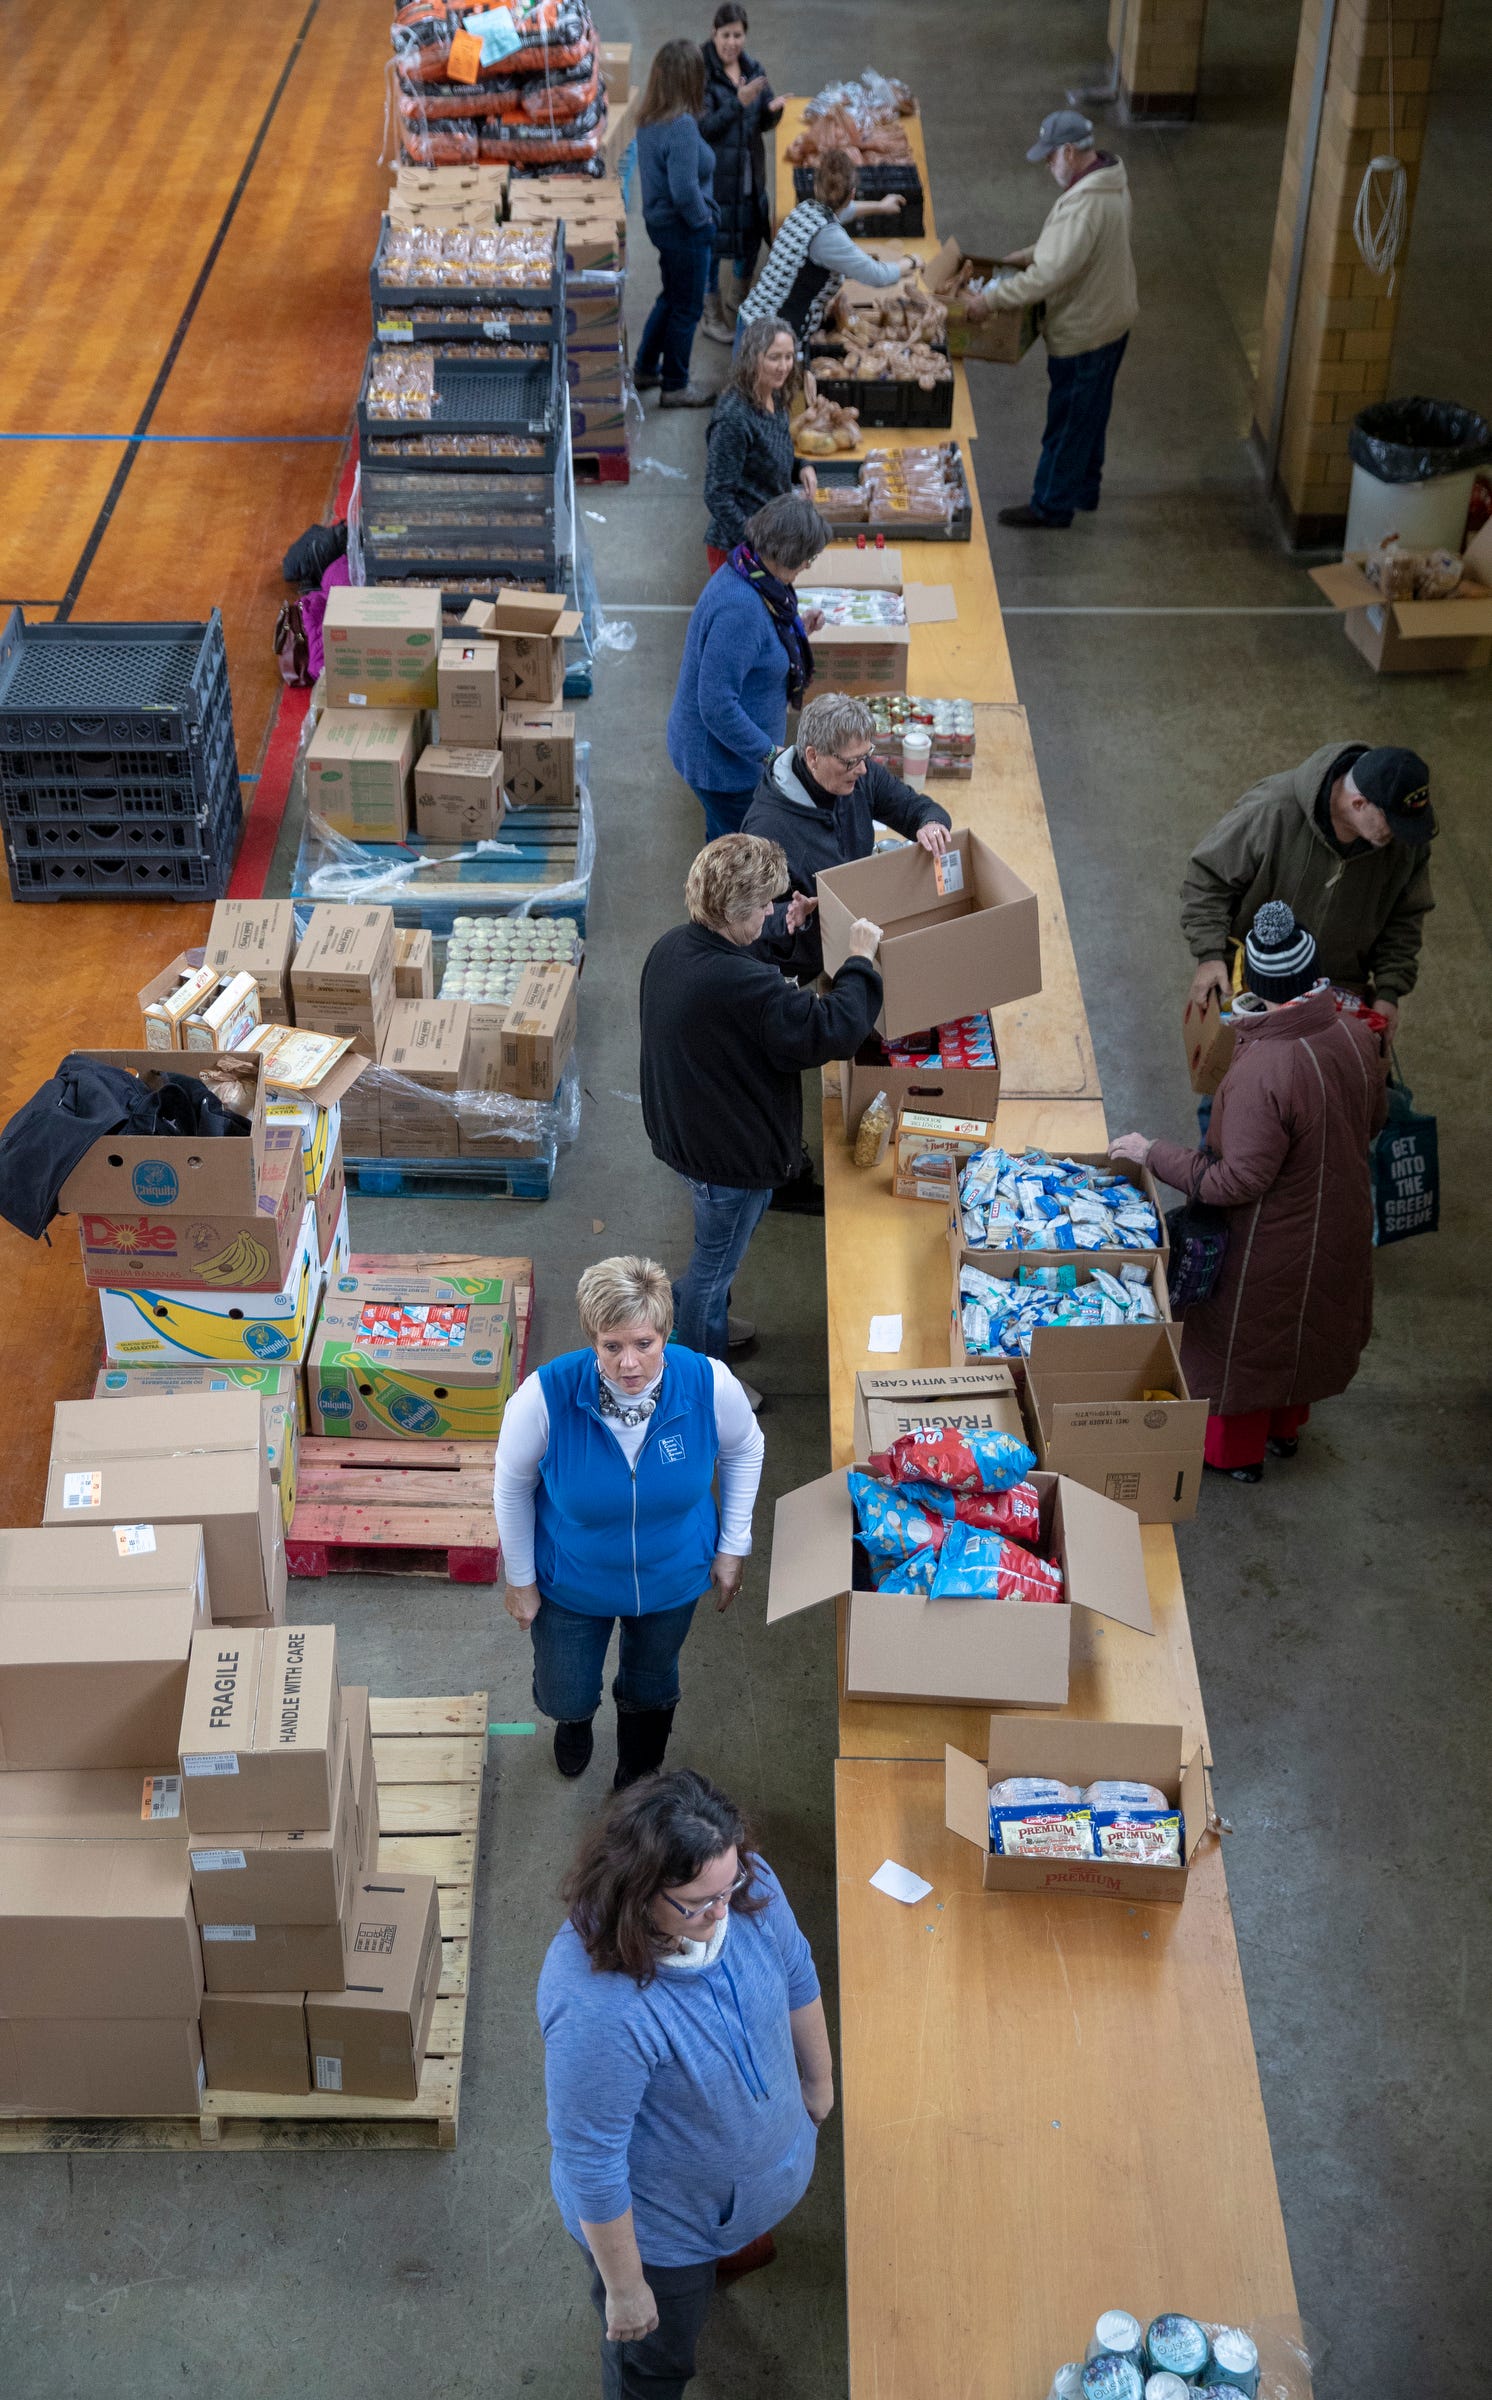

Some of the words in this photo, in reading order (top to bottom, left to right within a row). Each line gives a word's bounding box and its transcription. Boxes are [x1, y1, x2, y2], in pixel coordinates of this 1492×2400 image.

[1391, 1136, 1416, 1159] GET
[1391, 1155, 1425, 1179] INTO
[135, 1183, 177, 1198] Chiquita
[1396, 1175, 1424, 1198] THE
[1385, 1190, 1433, 1216] GREEN
[1385, 1207, 1432, 1232] SCENE
[134, 1270, 182, 1279] BANANAS
[254, 1336, 288, 1359] Chiquita
[871, 1378, 908, 1388] CARE
[912, 1376, 946, 1387] WITH
[949, 1373, 1005, 1384] HANDLE
[319, 1399, 351, 1411] Chiquita
[401, 1404, 433, 1429] Chiquita
[898, 1414, 993, 1432] FRAGILE
[1013, 1499, 1023, 1519] SALT
[1021, 1503, 1031, 1518] SEA
[289, 1633, 305, 1663] CARE
[209, 1650, 240, 1728] FRAGILE
[285, 1663, 302, 1695] WITH
[280, 1697, 300, 1743] HANDLE
[1018, 1824, 1076, 1839] PREMIUM
[1107, 1830, 1165, 1845] PREMIUM
[1045, 1871, 1121, 1891] PREMIUM
[1157, 2337, 1201, 2355] Outshine
